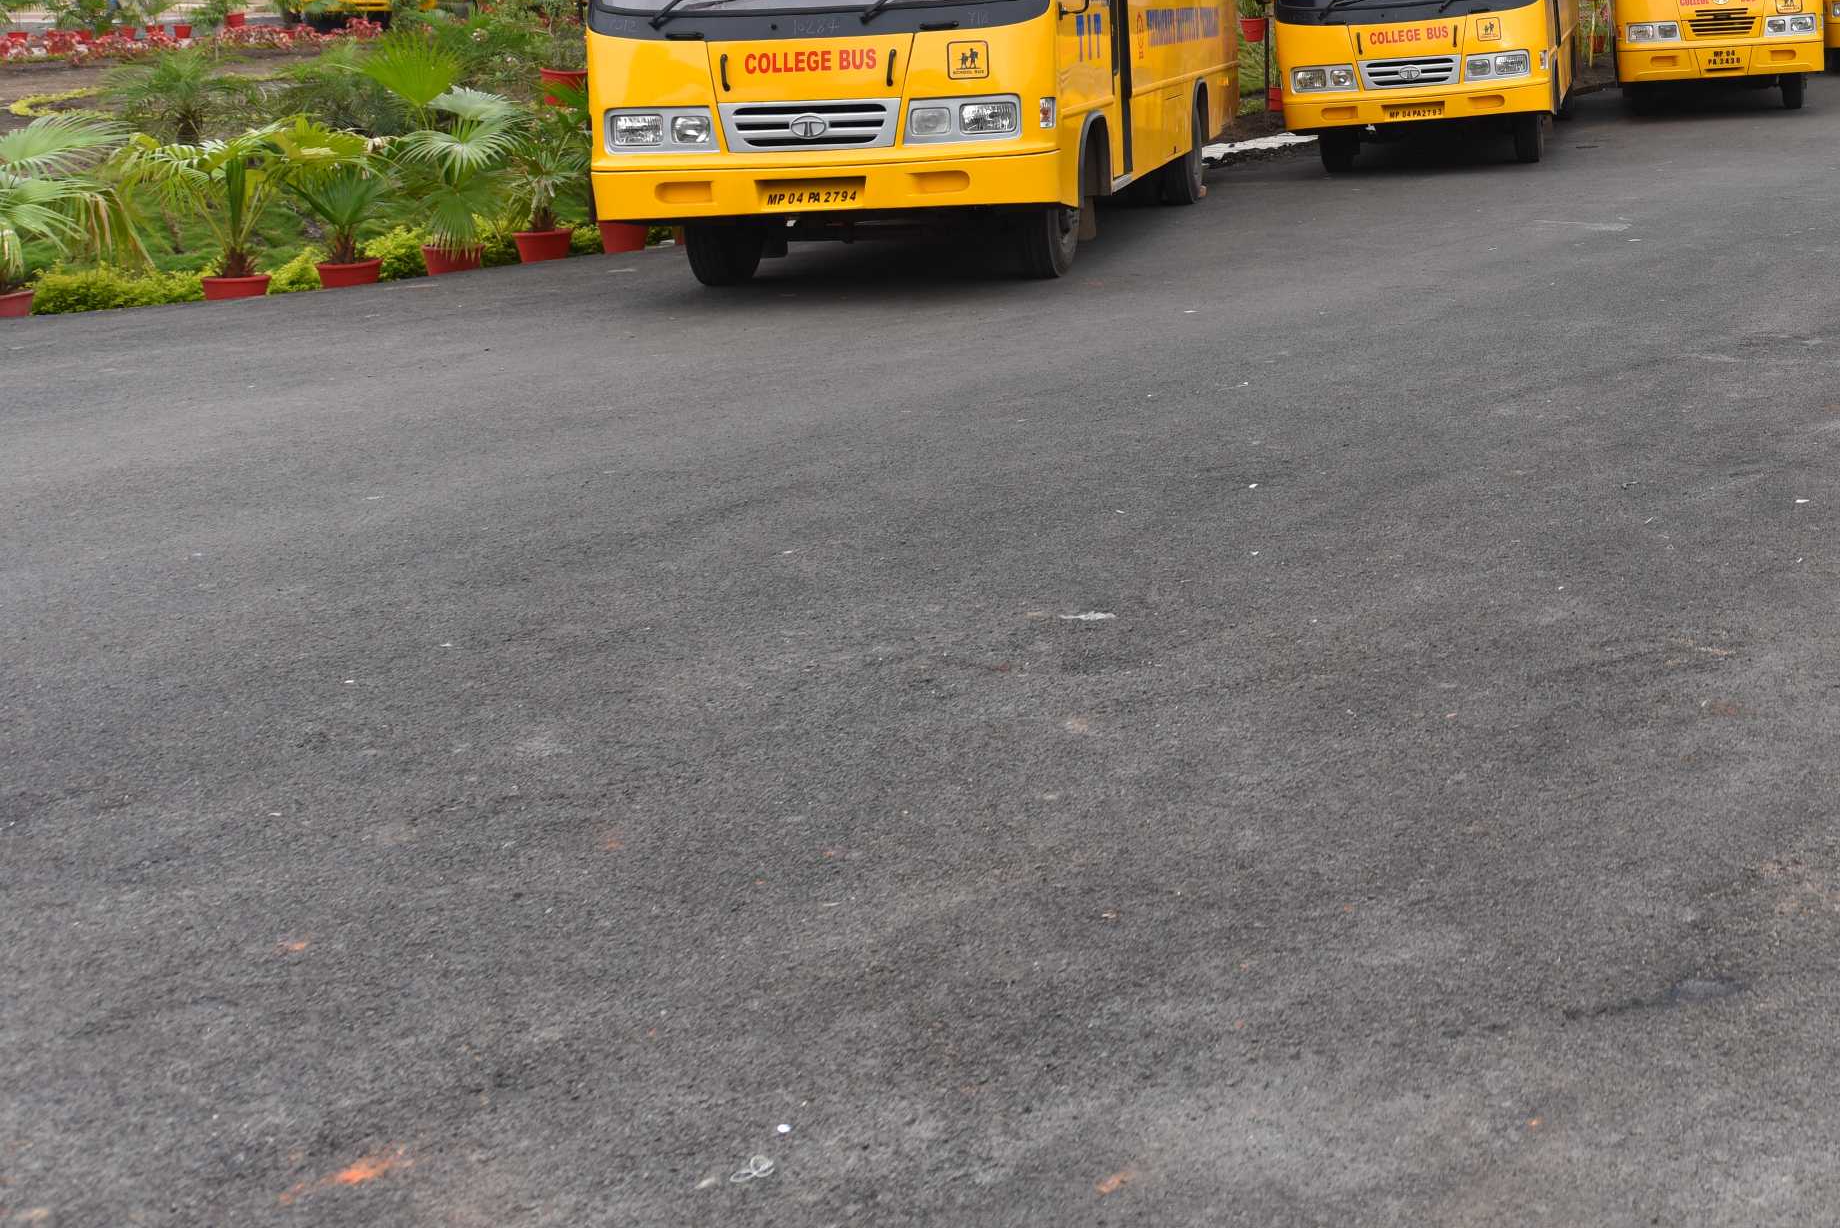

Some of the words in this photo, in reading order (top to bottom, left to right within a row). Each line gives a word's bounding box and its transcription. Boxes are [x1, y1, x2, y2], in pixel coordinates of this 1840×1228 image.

[1076, 12, 1102, 63] TIT
[1369, 28, 1421, 45] COLLEGE
[1426, 25, 1449, 40] BUS
[744, 50, 832, 75] COLLEGE
[839, 48, 877, 71] BUS
[1389, 110, 1400, 118] MP
[1402, 109, 1411, 118] 04
[766, 192, 785, 206] MP
[787, 192, 804, 205] 04
[807, 191, 822, 204] PA
[824, 189, 858, 203] 2794
